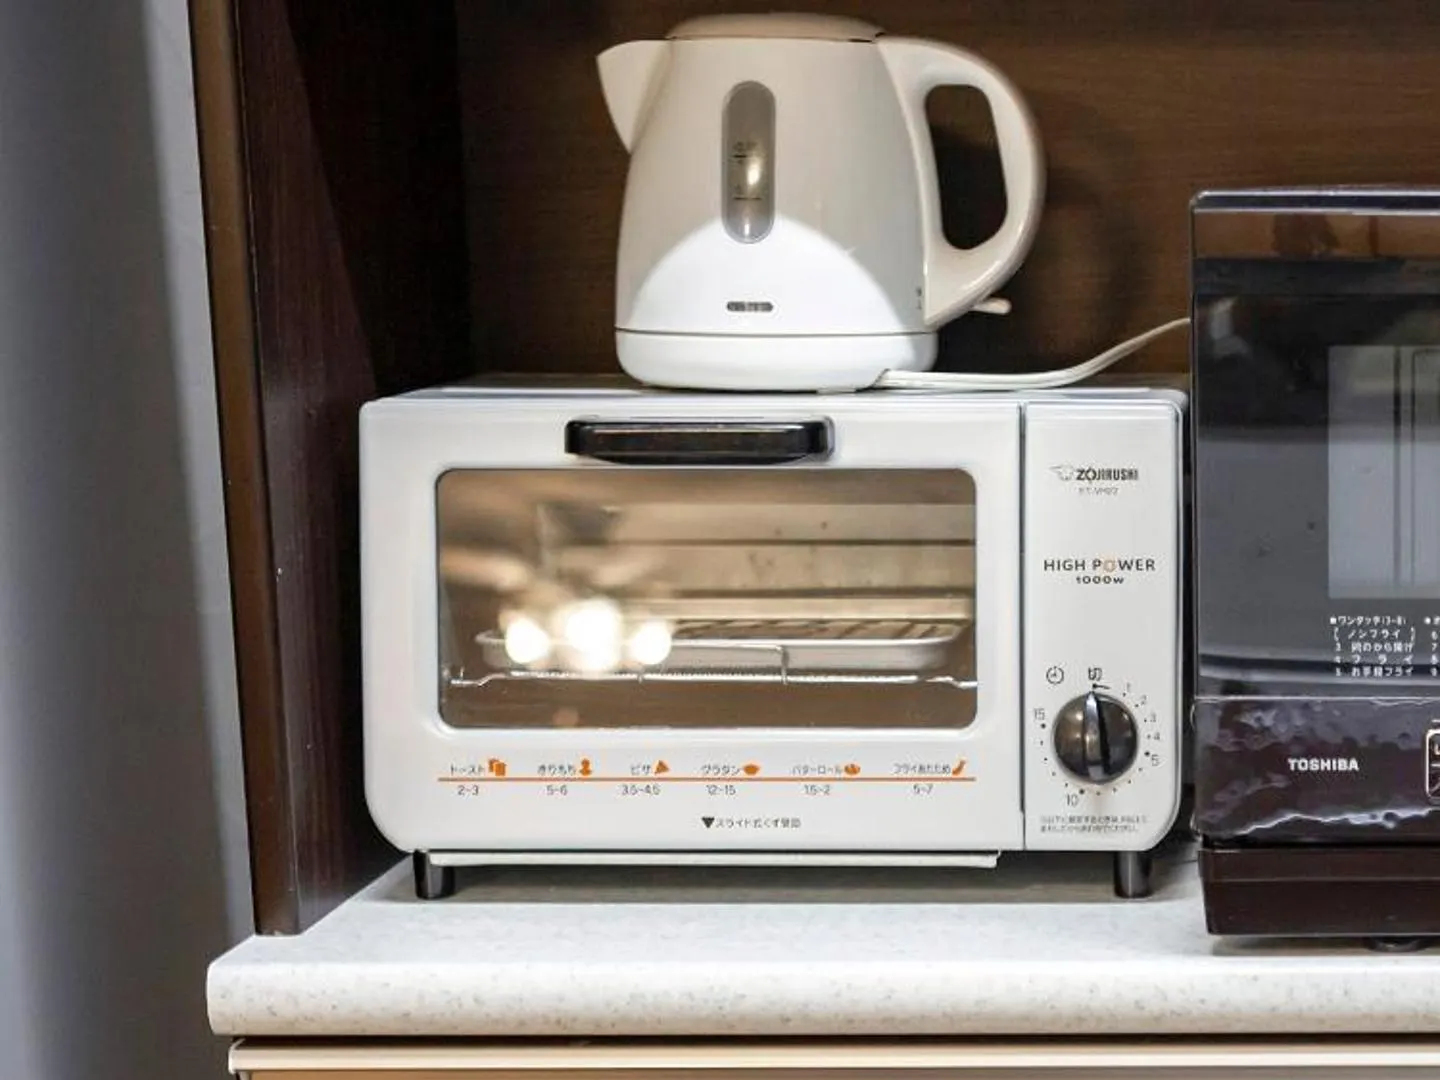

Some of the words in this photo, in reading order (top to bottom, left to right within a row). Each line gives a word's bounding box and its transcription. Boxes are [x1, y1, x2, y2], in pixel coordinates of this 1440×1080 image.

[1075, 468, 1139, 481] ZOJIRUSHI
[1043, 559, 1086, 571] HIGH
[1092, 559, 1156, 572] POWER
[1287, 758, 1360, 772] TOSHIBA
